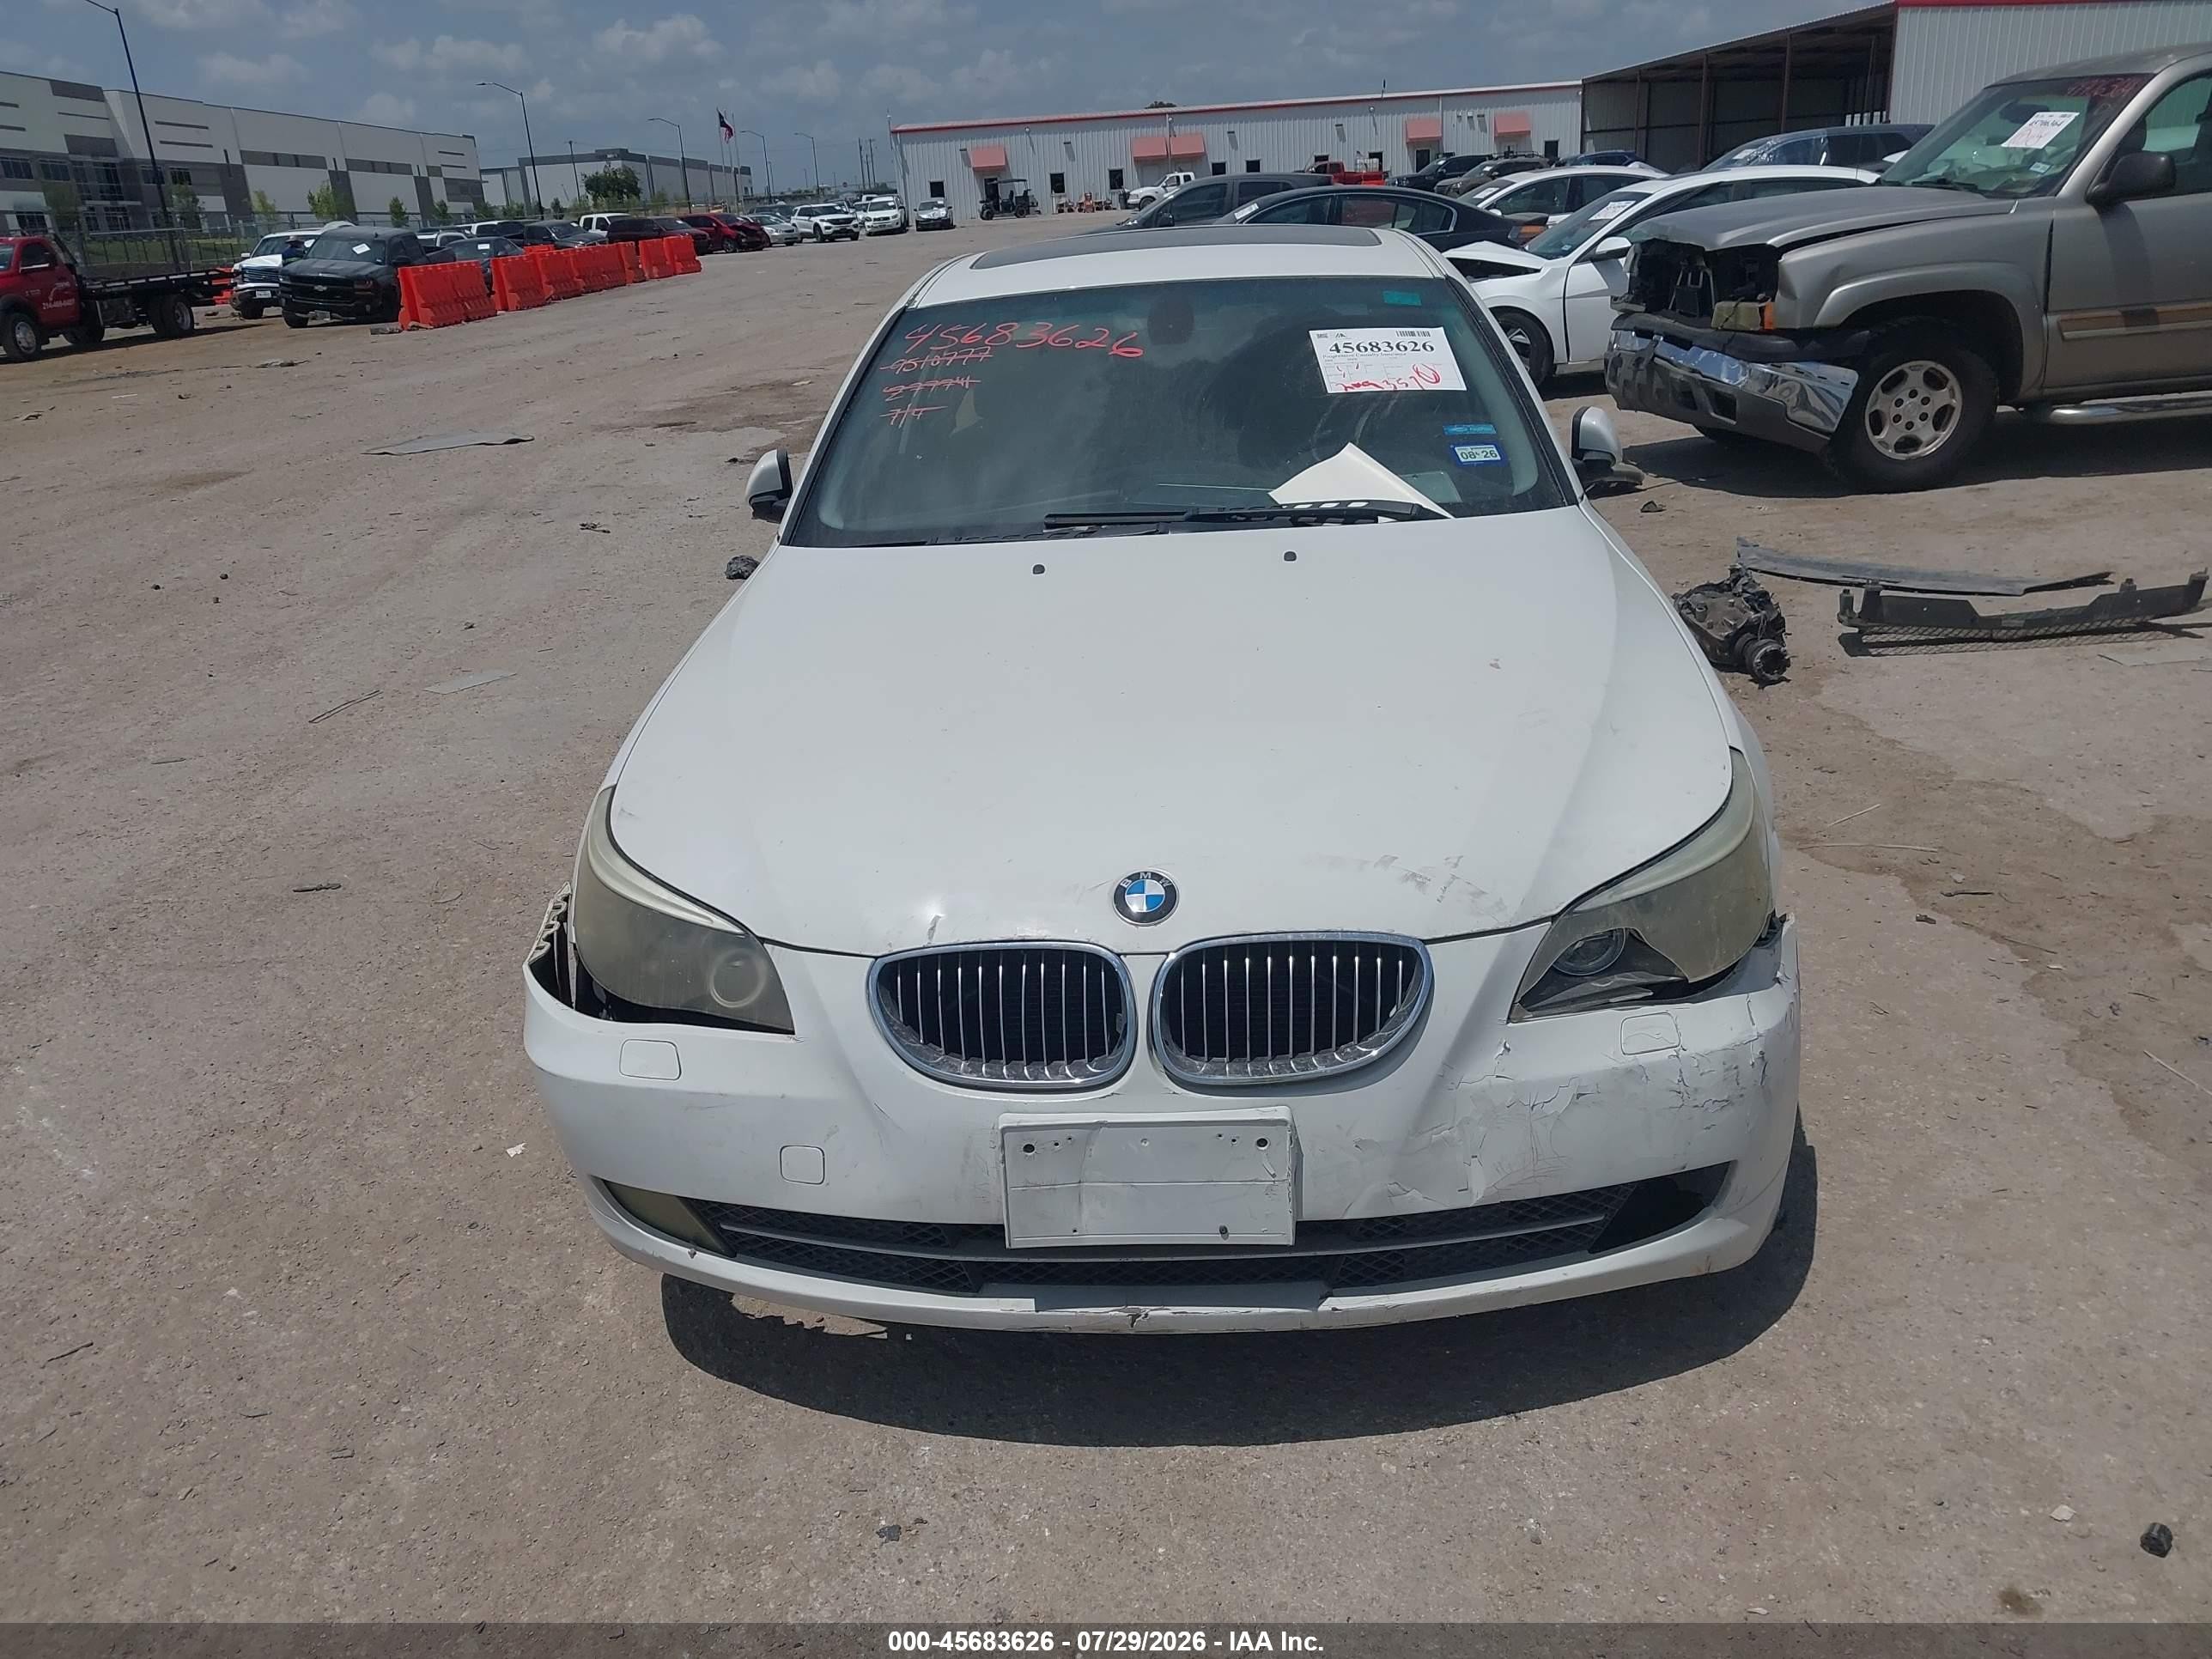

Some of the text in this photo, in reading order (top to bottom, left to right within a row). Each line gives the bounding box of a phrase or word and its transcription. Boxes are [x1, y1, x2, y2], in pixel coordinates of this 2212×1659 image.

[904, 323, 1144, 357] 45683626
[1329, 341, 1435, 354] 45683626
[1460, 450, 1498, 460] 08 26
[1120, 872, 1171, 888] BMW
